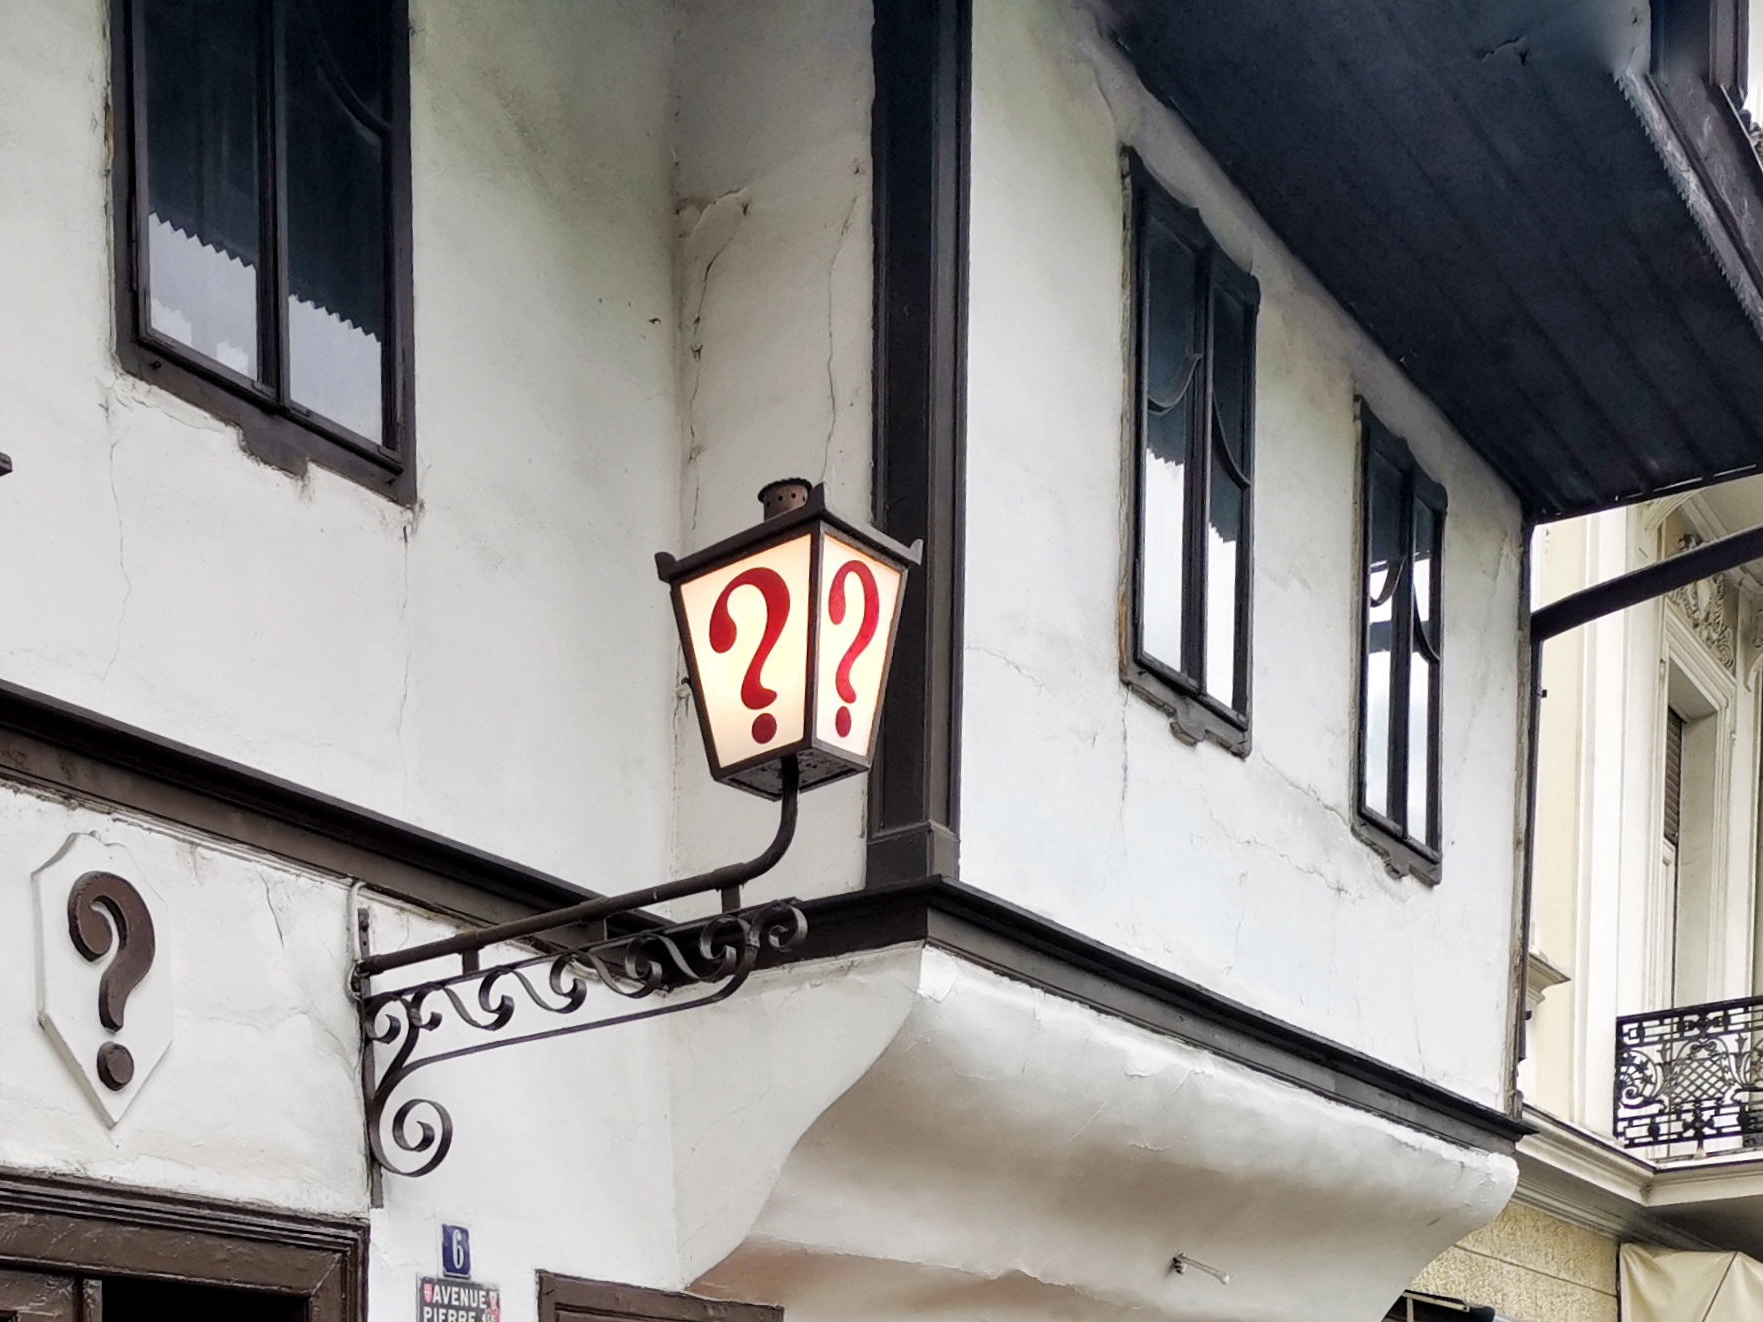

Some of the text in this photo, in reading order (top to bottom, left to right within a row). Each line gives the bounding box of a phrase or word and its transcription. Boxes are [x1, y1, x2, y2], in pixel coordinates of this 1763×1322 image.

[709, 567, 791, 744] ?
[828, 560, 880, 738] ?
[67, 870, 156, 1091] ?
[432, 1285, 487, 1309] AVENUE
[452, 1229, 465, 1270] 6
